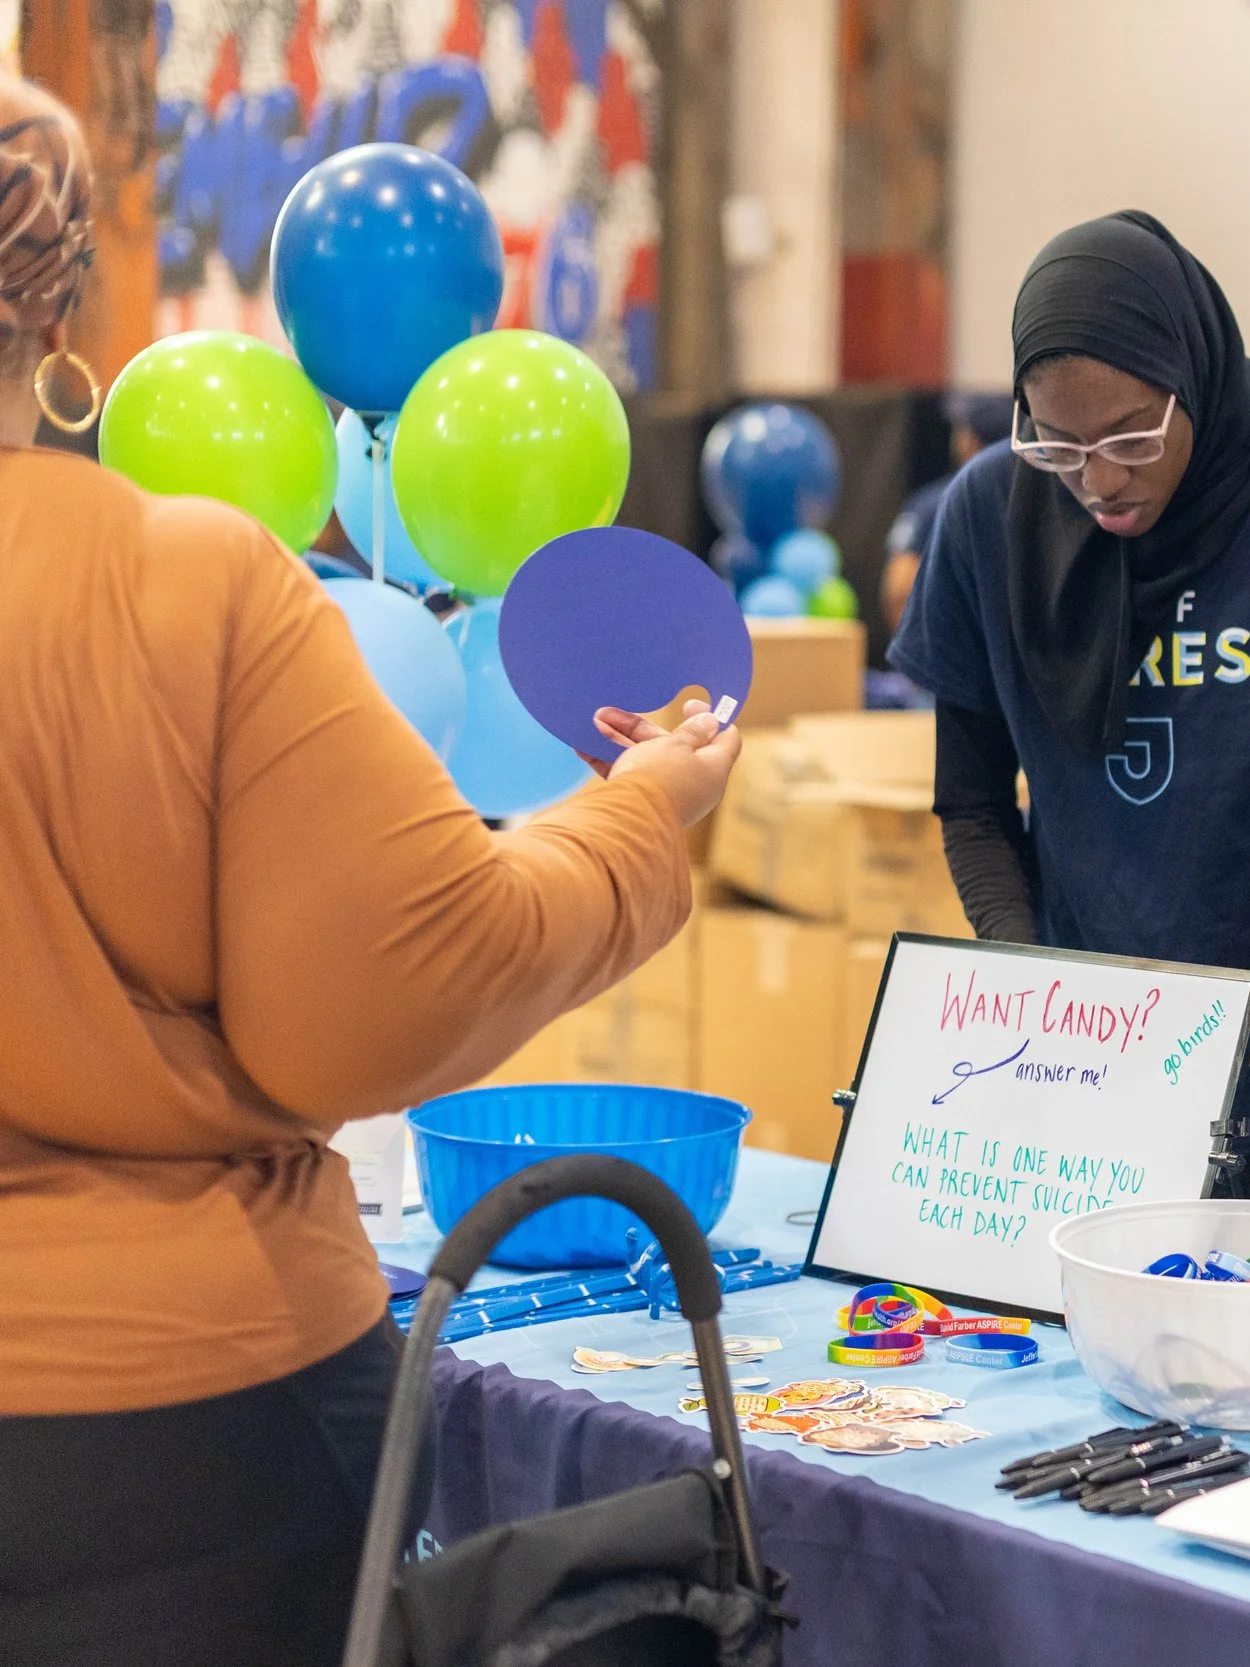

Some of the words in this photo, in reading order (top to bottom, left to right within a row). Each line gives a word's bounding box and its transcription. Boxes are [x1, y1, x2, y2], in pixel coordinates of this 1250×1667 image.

[940, 969, 1036, 1032] WANT
[1042, 980, 1161, 1053] CANDY?
[1016, 1060, 1076, 1083] answer
[1080, 1064, 1107, 1090] me!
[1163, 1053, 1182, 1085] go
[903, 1122, 970, 1164] WHAT
[981, 1140, 1001, 1168] IS
[1013, 1146, 1048, 1175] ONE
[1059, 1155, 1104, 1192] WAY
[1108, 1159, 1145, 1196] YOU
[891, 1161, 929, 1189] CAN
[939, 1168, 1028, 1204] PREVENT
[919, 1199, 964, 1231] EACH
[973, 1211, 1027, 1248] DAY?
[954, 1321, 977, 1332] Farber
[977, 1319, 1002, 1330] ASPIRE
[1003, 1321, 1023, 1331] Center
[871, 1354, 898, 1364] ASPIRE
[976, 1355, 1003, 1365] Center
